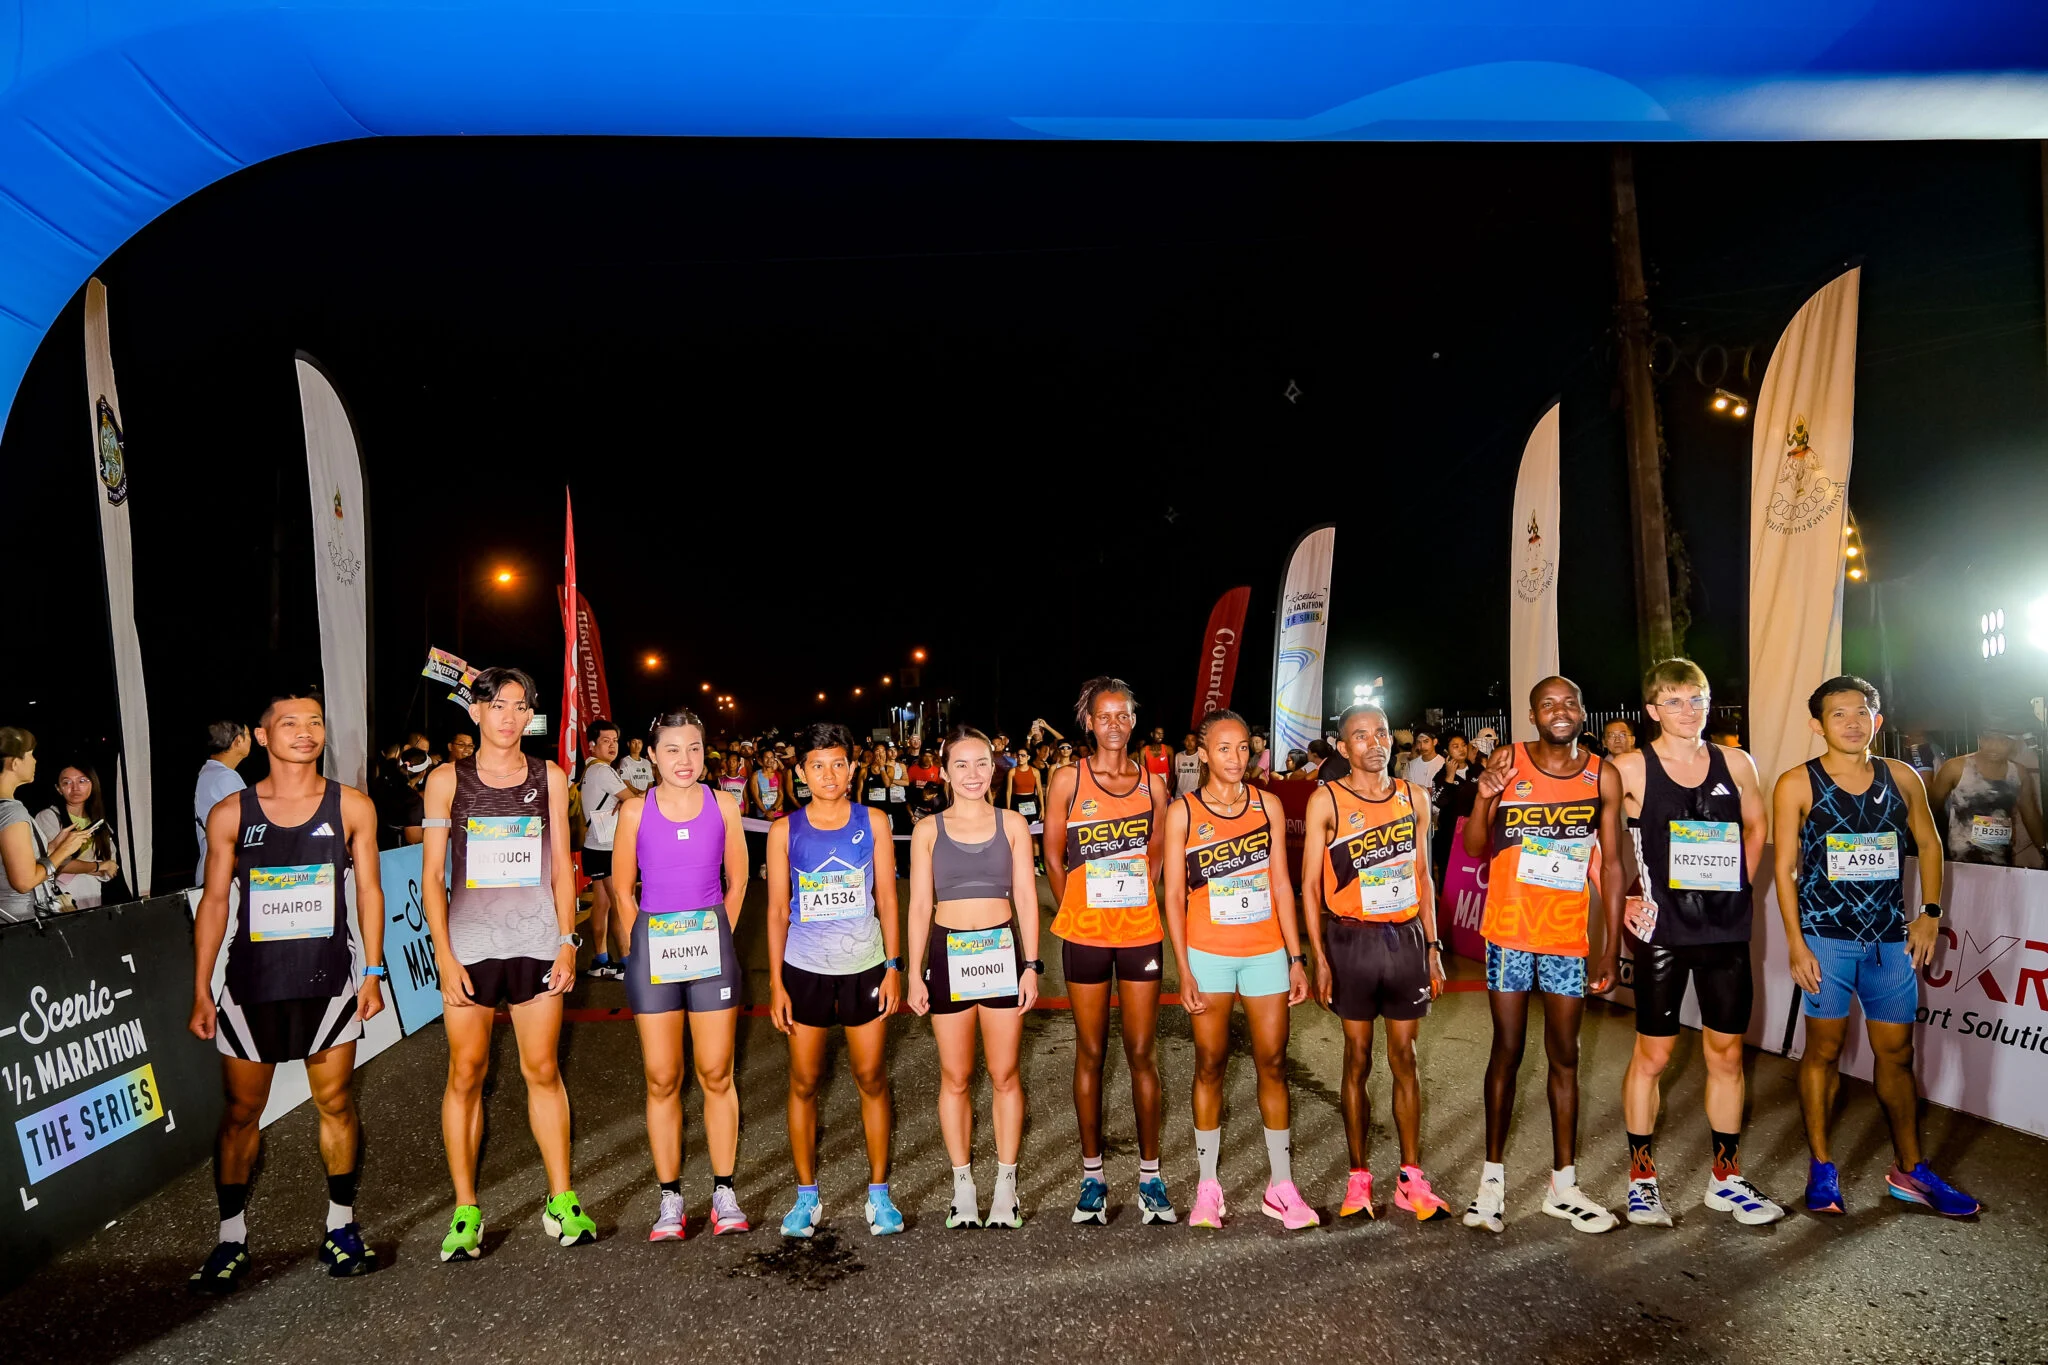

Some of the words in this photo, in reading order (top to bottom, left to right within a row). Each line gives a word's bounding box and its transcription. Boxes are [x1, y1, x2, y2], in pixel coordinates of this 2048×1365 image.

[432, 661, 460, 680] SWEEPER
[1203, 627, 1235, 717] Counte
[1505, 805, 1596, 827] DEVER
[243, 823, 268, 844] 119
[1078, 819, 1149, 845] DEVER
[1505, 826, 1560, 838] ENERGY
[1565, 825, 1589, 836] GEL
[1080, 839, 1125, 855] ENERGY
[1347, 822, 1414, 859] DEVER
[1198, 831, 1269, 868] DEVER
[1201, 854, 1246, 878] ENERGY
[1250, 848, 1268, 862] GEL
[1551, 861, 1560, 873] 6
[1674, 854, 1738, 867] KRZYSZTOF
[1848, 853, 1885, 866] A986
[1117, 880, 1125, 892] 7
[1392, 886, 1399, 897] 9
[813, 890, 856, 906] A1536
[1241, 897, 1249, 909] 8
[262, 900, 322, 915] CHAIROB
[661, 945, 709, 960] ARUNYA
[961, 963, 1004, 978] MOONOI
[19, 979, 115, 1044] Scenic
[34, 1018, 148, 1095] MARATHON
[26, 1114, 76, 1167] THE
[79, 1078, 154, 1141] SERIES
